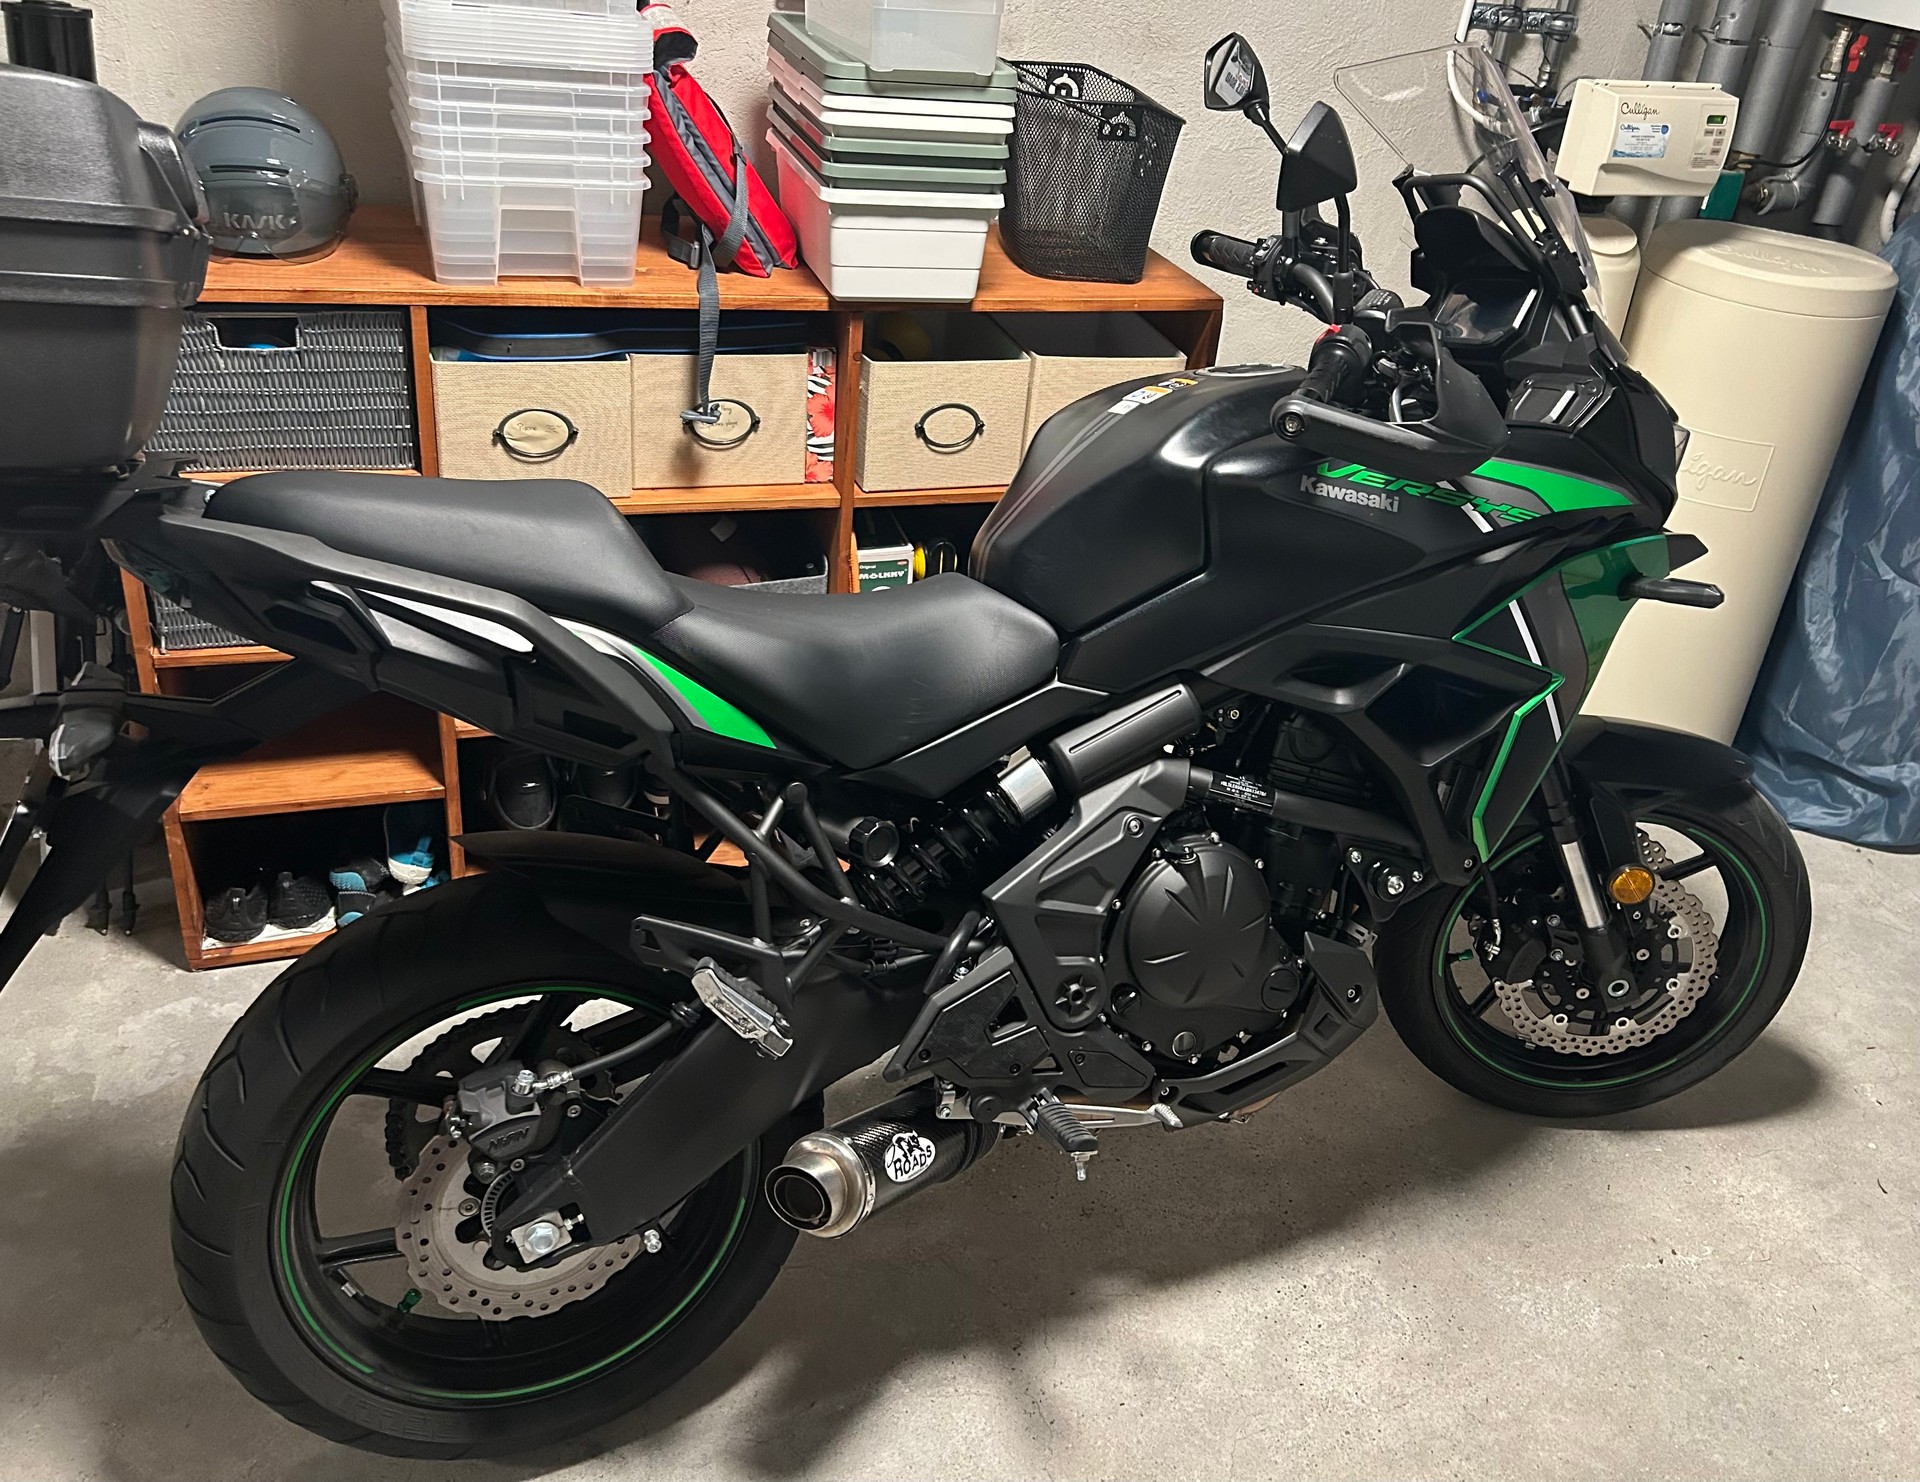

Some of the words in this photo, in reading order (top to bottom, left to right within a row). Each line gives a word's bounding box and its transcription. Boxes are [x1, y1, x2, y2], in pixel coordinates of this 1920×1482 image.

[1620, 102, 1660, 121] Culligan
[223, 212, 286, 231] KASK
[1680, 451, 1758, 492] igan
[1300, 474, 1400, 513] Kawasaki
[1316, 462, 1543, 524] VERSYS
[893, 1144, 933, 1181] ROADS
